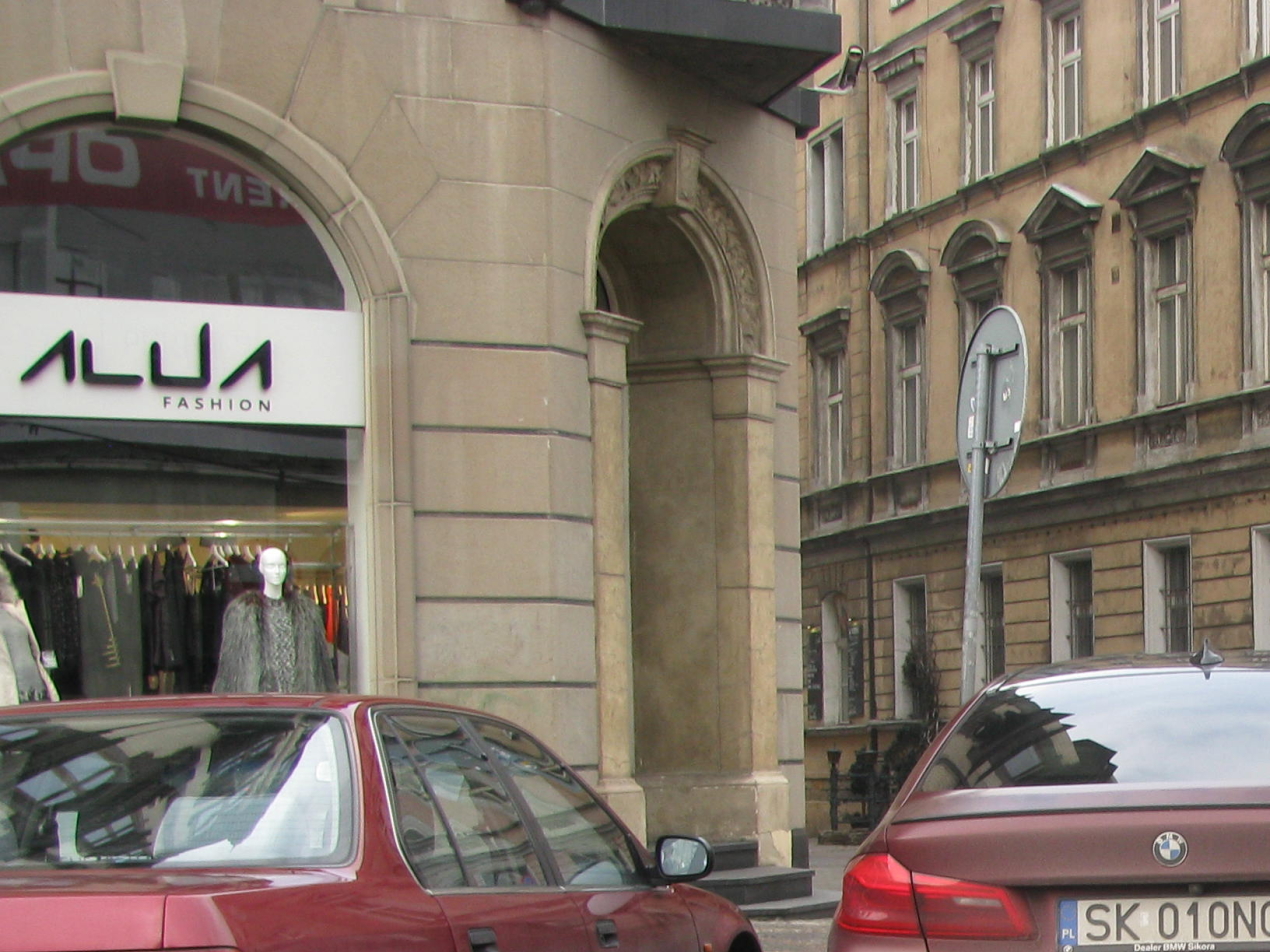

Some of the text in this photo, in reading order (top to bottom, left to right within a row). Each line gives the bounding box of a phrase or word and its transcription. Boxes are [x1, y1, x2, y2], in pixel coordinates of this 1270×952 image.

[163, 396, 272, 412] FASHION
[1062, 929, 1075, 939] PL
[1085, 903, 1141, 941] SK
[1133, 942, 1216, 952] Dealer BMW Sikora
